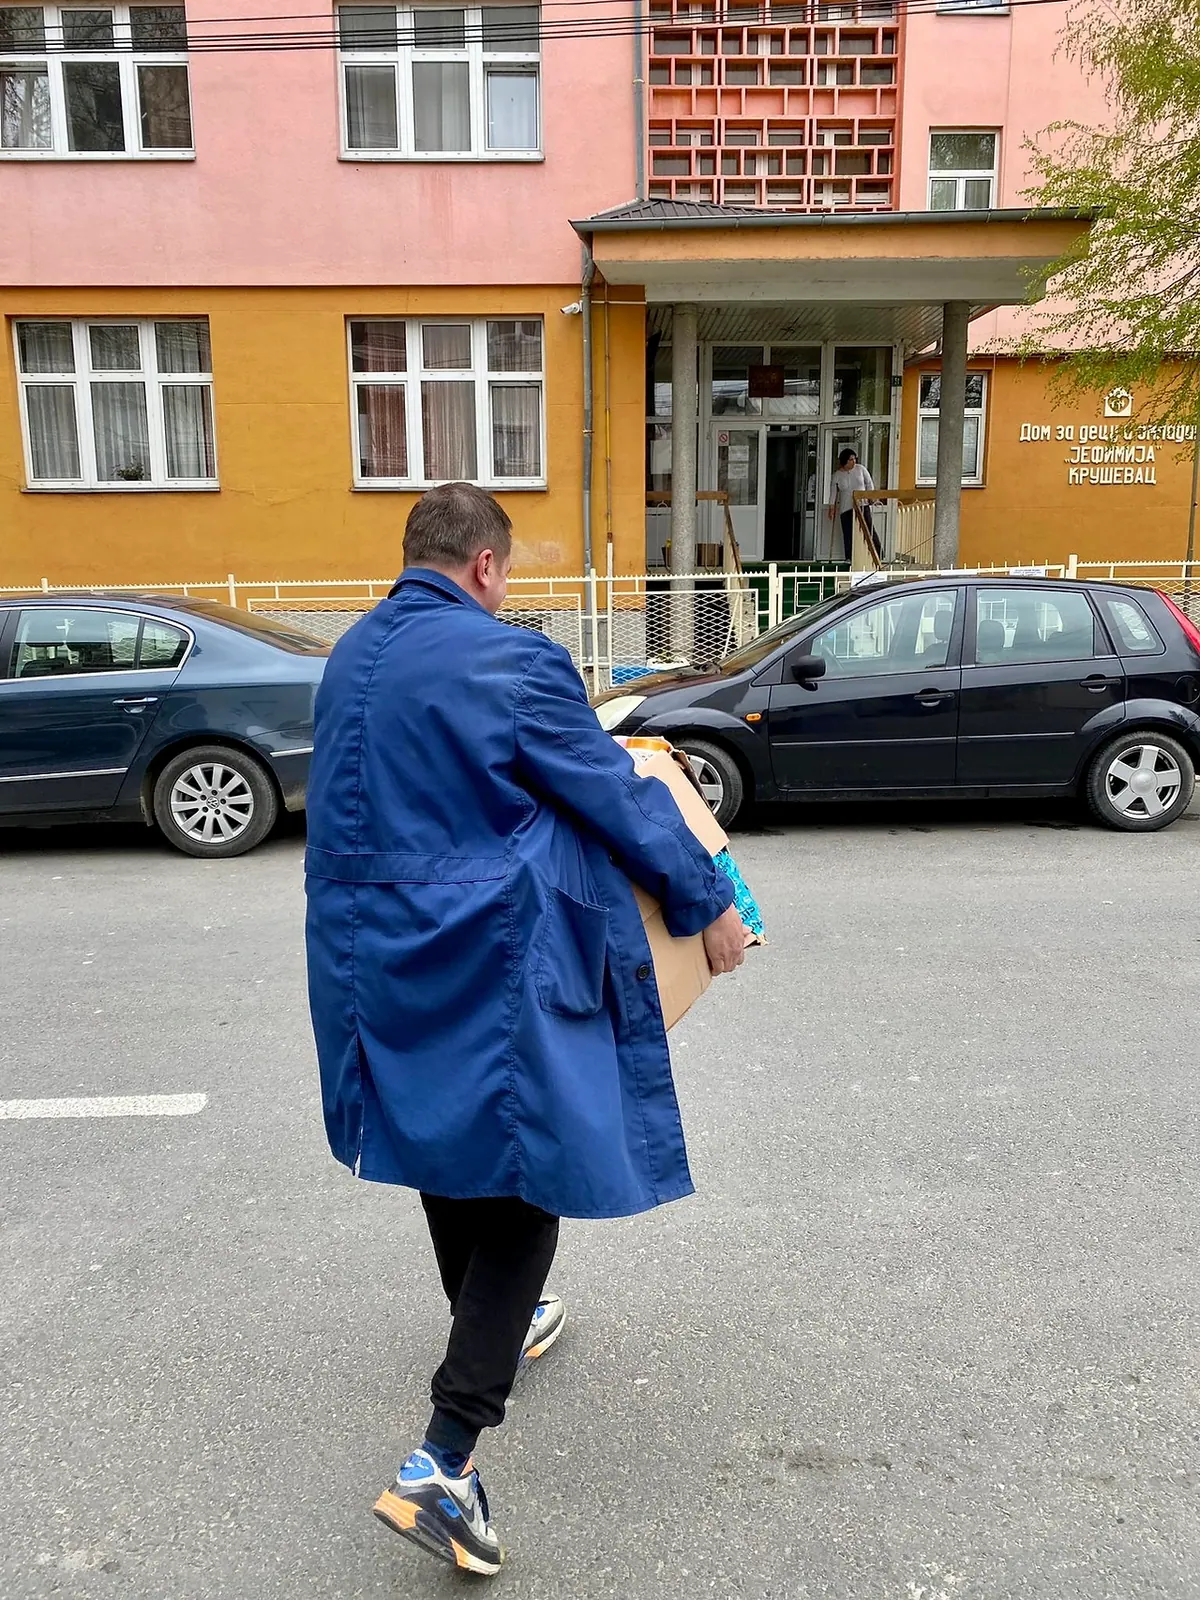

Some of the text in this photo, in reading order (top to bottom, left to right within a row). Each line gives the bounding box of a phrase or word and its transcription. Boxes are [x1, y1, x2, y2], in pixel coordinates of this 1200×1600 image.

[1020, 423, 1051, 441] Дом
[1056, 425, 1074, 441] за
[1068, 467, 1157, 485] КРУШЕВАЦ
